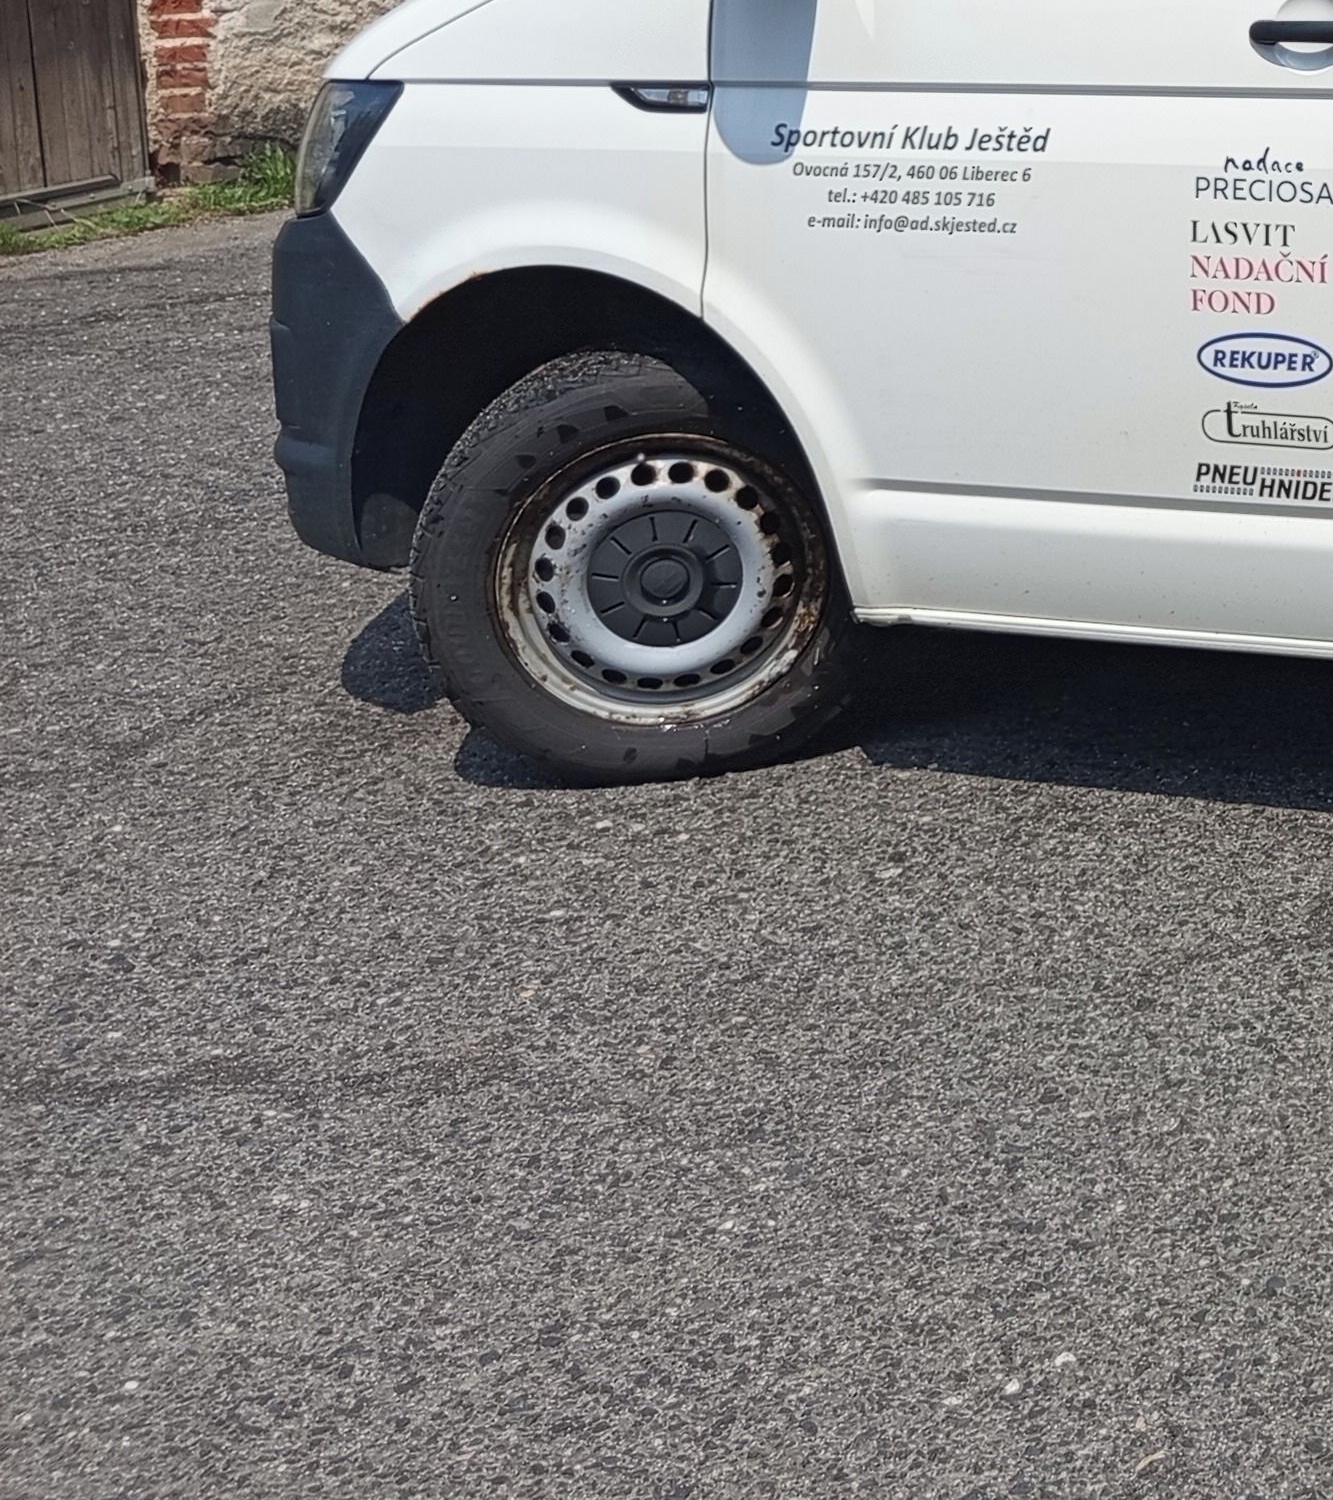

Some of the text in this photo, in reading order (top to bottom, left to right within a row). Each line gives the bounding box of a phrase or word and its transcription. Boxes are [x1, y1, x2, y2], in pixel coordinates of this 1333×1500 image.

[771, 123, 1051, 153] Sportovní Klub Ještěd
[792, 161, 1032, 183] Ovocná 157/2, 460 06 Liberec 6
[1223, 146, 1305, 175] nadace
[827, 187, 995, 207] tel.: +420 485 105 716
[807, 213, 1018, 236] e-mail: info@ad.skjested.cz
[1190, 219, 1296, 248] LASVIT
[1190, 250, 1329, 284] NADAČNÍ
[1191, 288, 1276, 315] FOND
[1223, 400, 1329, 444] truhlářství
[1195, 462, 1259, 486] PNEU
